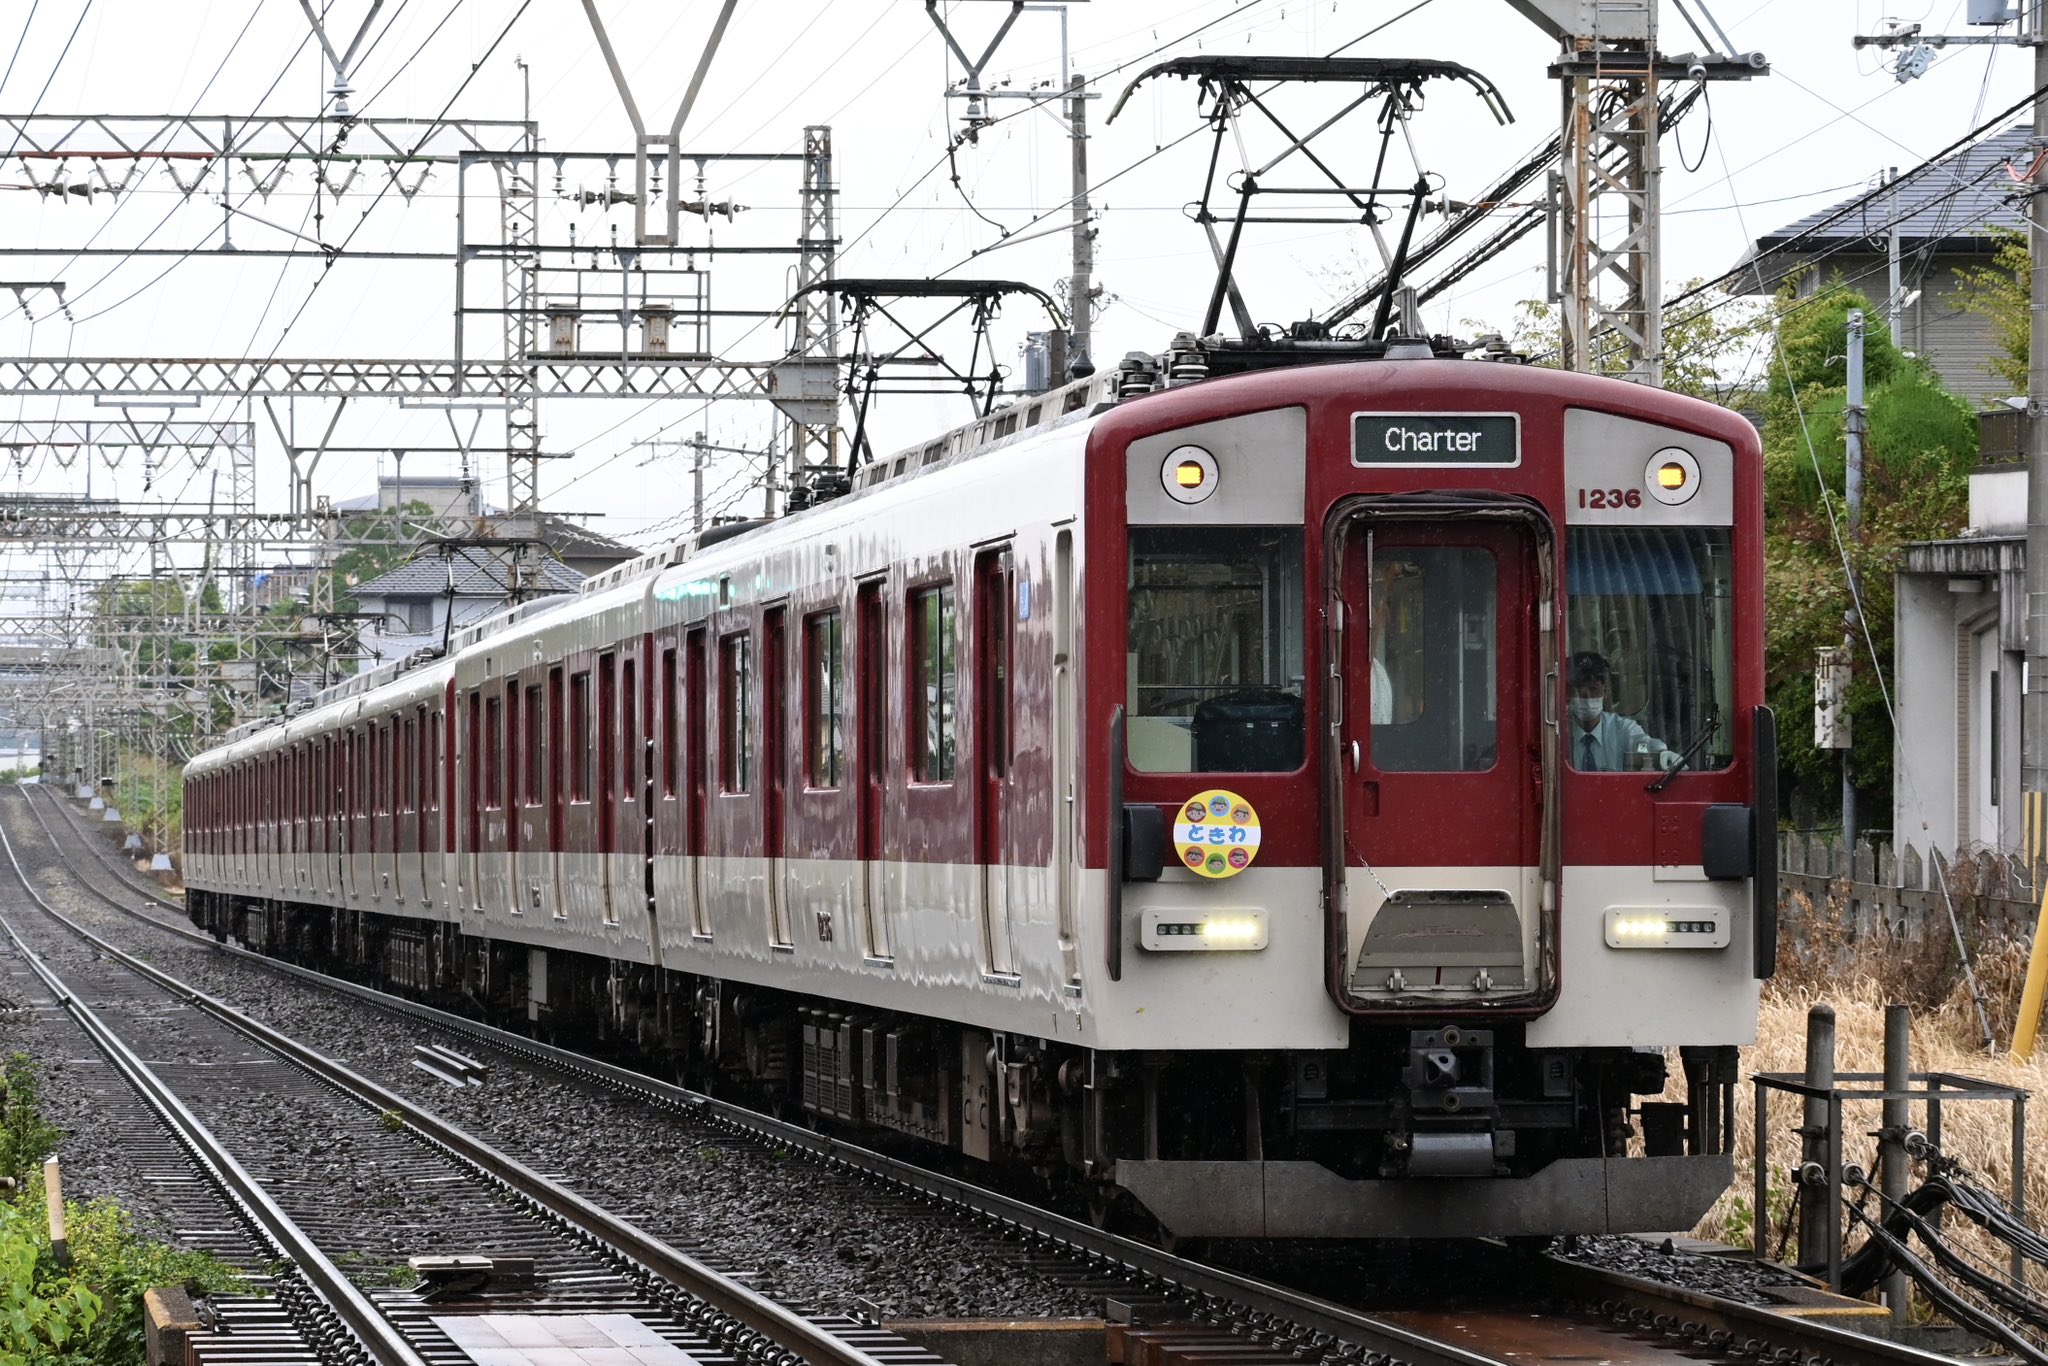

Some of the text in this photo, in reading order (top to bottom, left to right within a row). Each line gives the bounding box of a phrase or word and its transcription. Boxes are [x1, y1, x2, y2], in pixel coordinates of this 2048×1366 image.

[1385, 427, 1482, 452] Charter
[1579, 488, 1642, 509] 1236
[1188, 824, 1246, 845] ときわ
